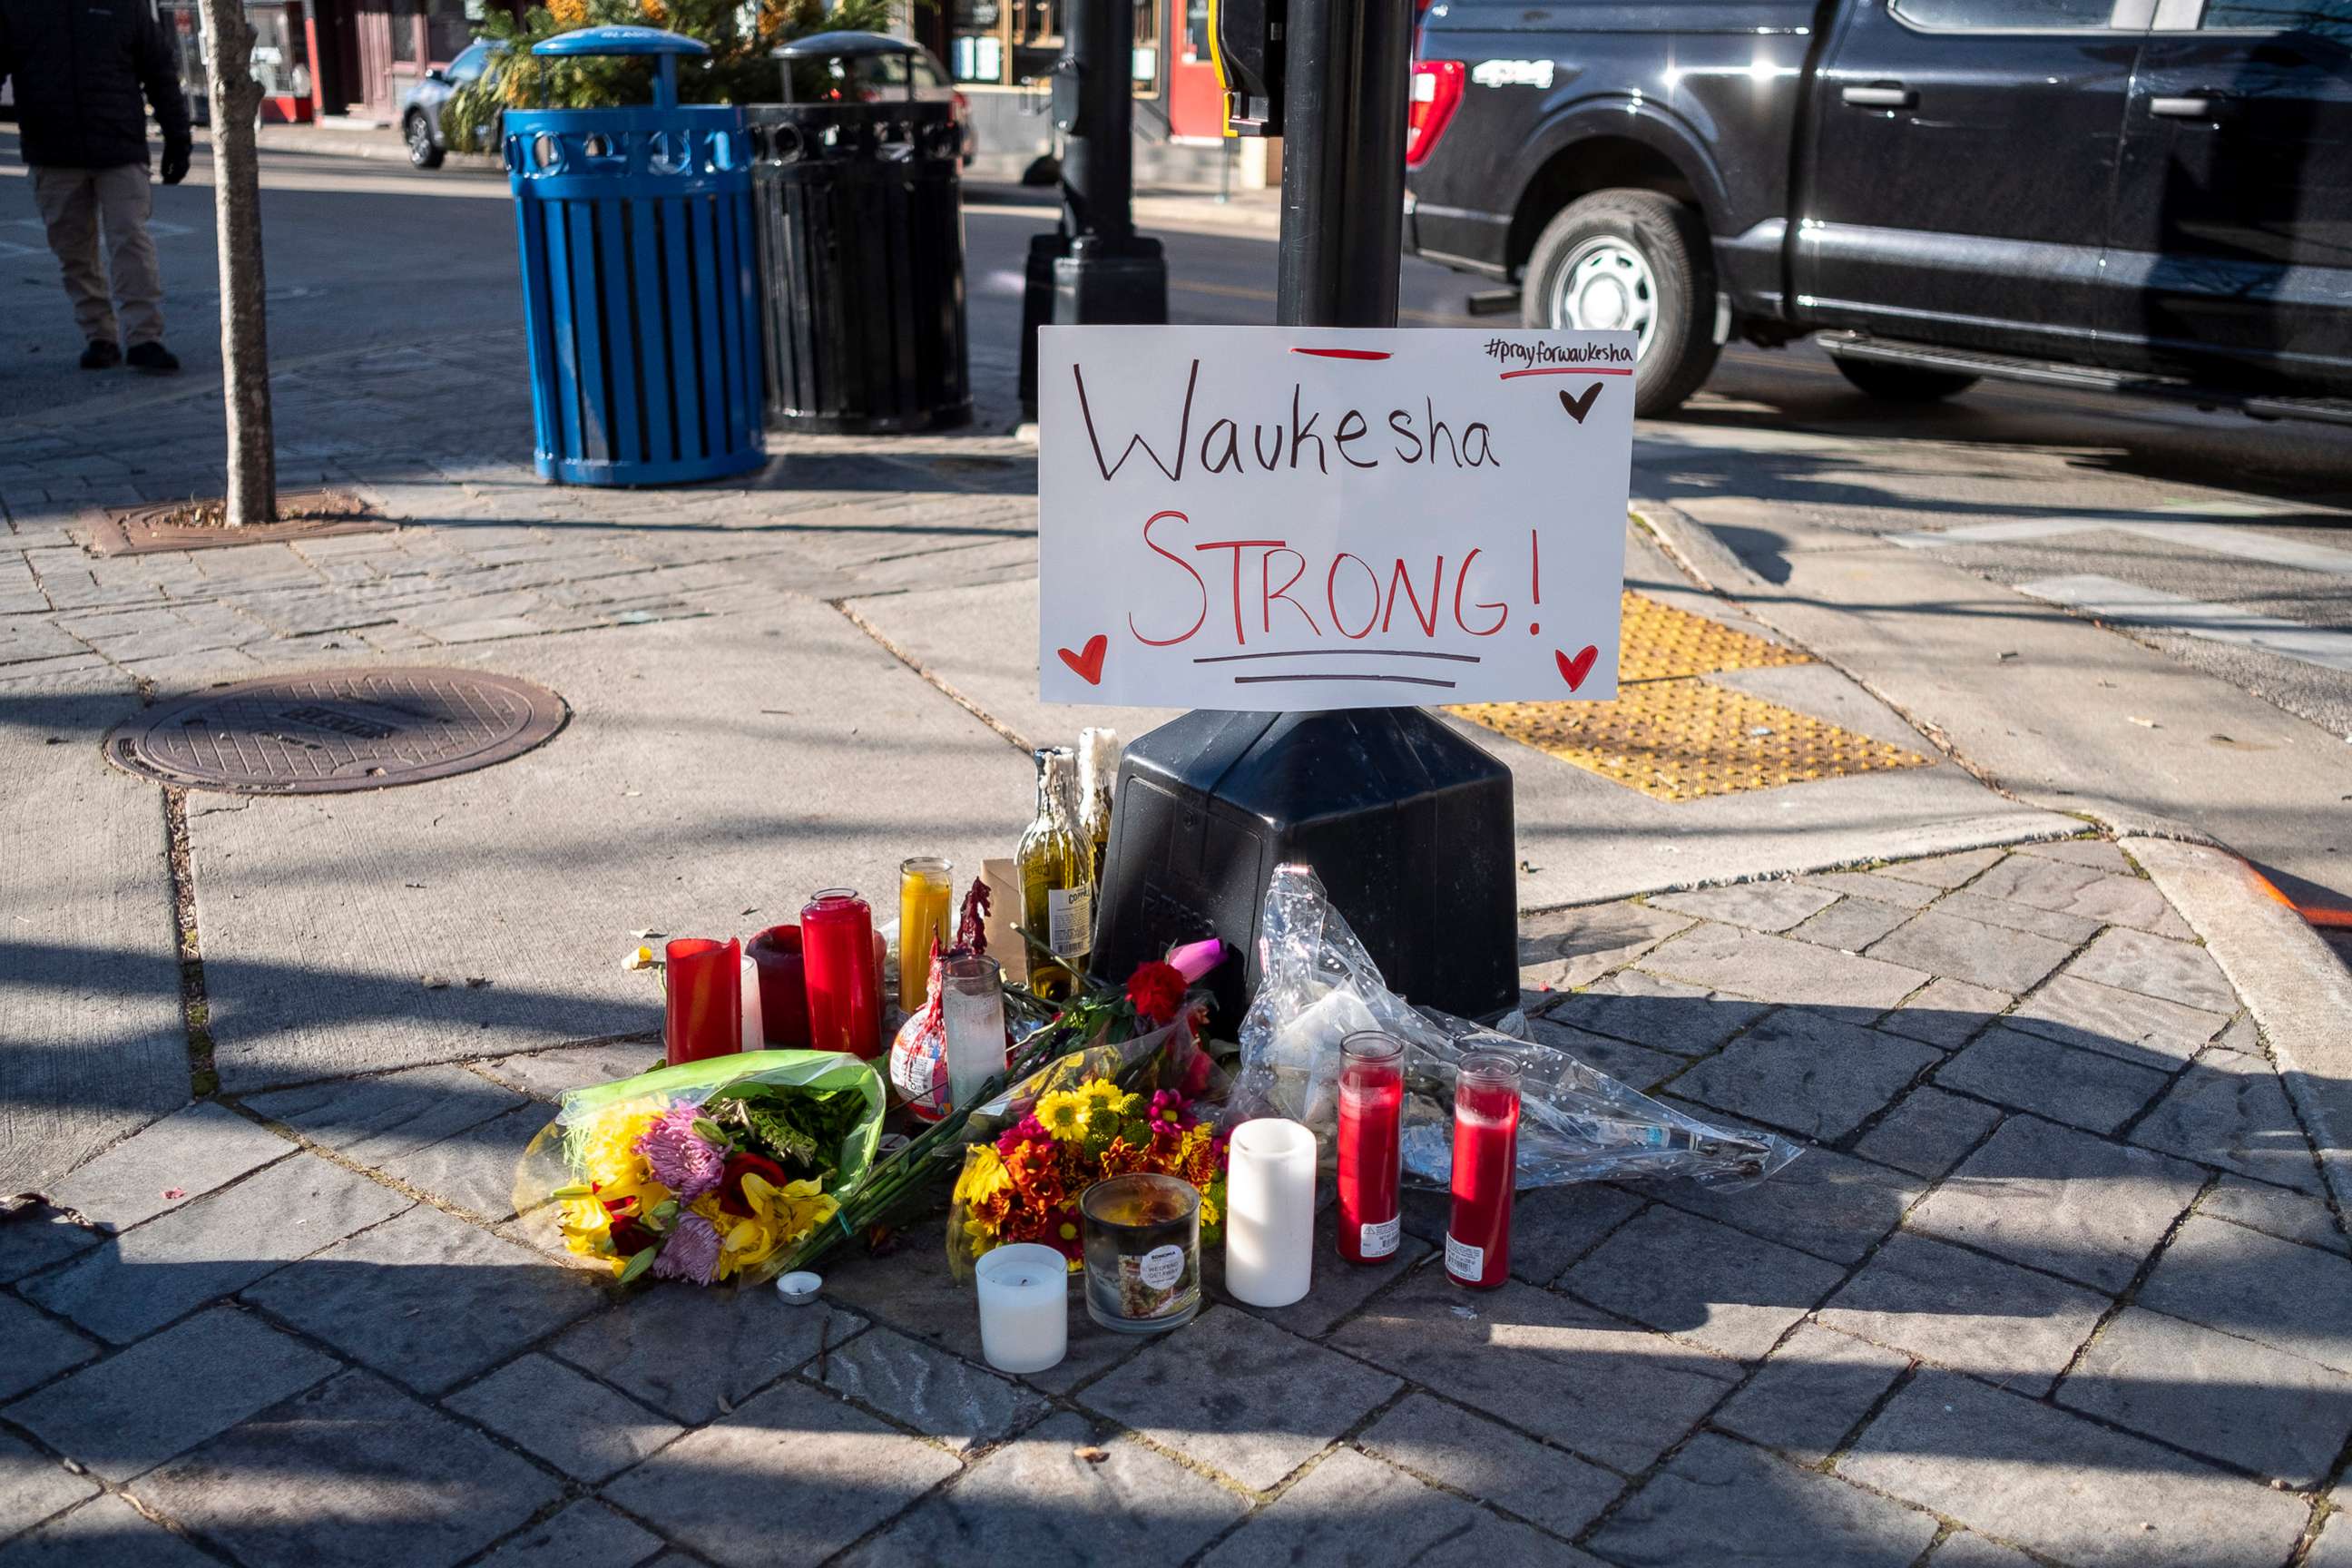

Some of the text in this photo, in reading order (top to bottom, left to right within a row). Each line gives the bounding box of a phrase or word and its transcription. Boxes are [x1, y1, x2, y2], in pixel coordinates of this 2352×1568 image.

[1484, 338, 1632, 368] #prayforwaukesha
[1073, 359, 1500, 482] Waukesha
[1129, 510, 1541, 647] STRONG!
